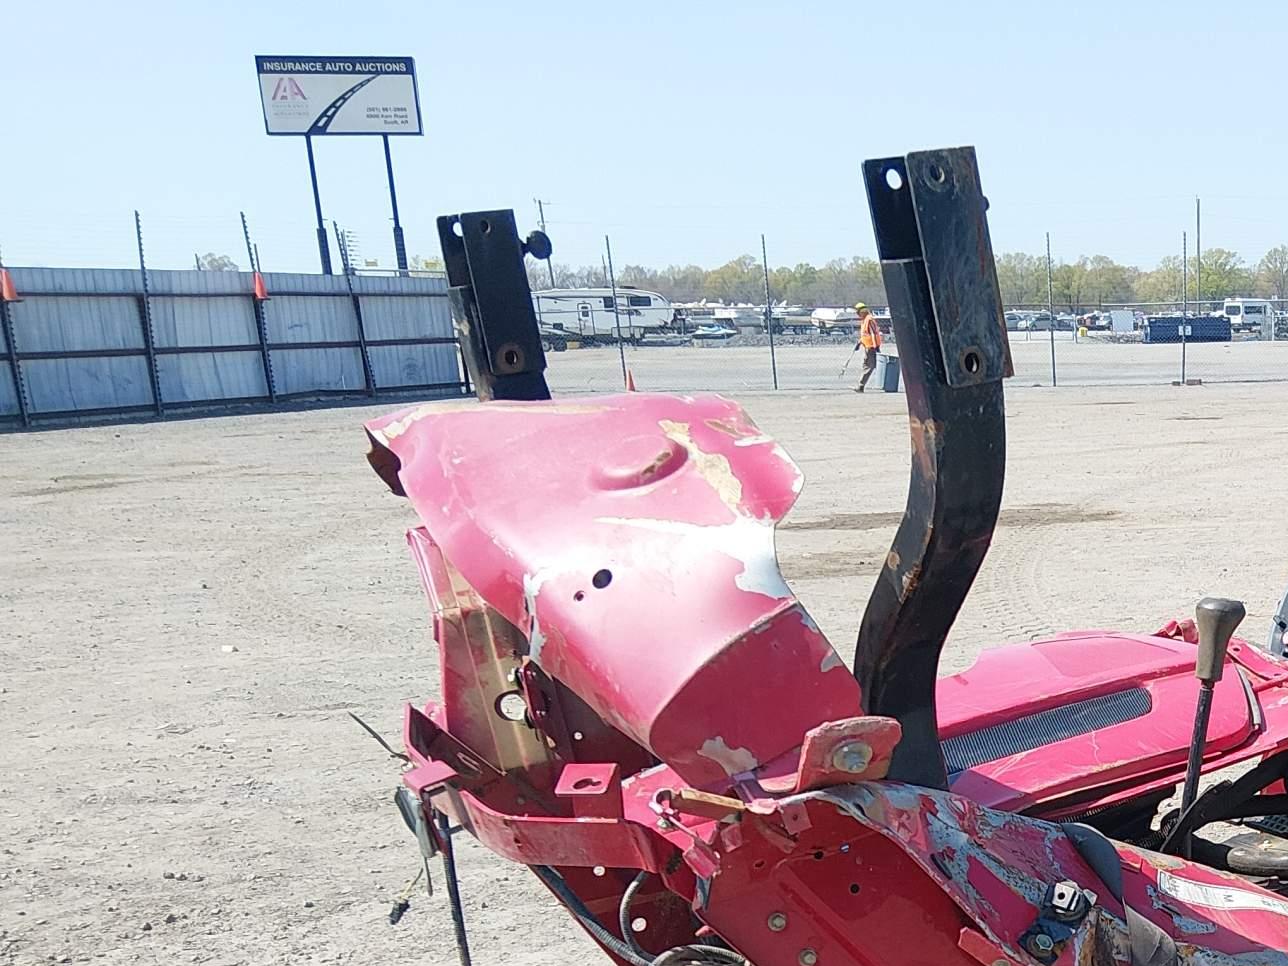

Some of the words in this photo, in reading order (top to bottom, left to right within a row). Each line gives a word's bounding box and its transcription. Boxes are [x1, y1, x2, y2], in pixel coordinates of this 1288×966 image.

[263, 62, 323, 71] INSURANCE
[325, 62, 353, 71] AUTO
[355, 62, 407, 72] AUCTIONS
